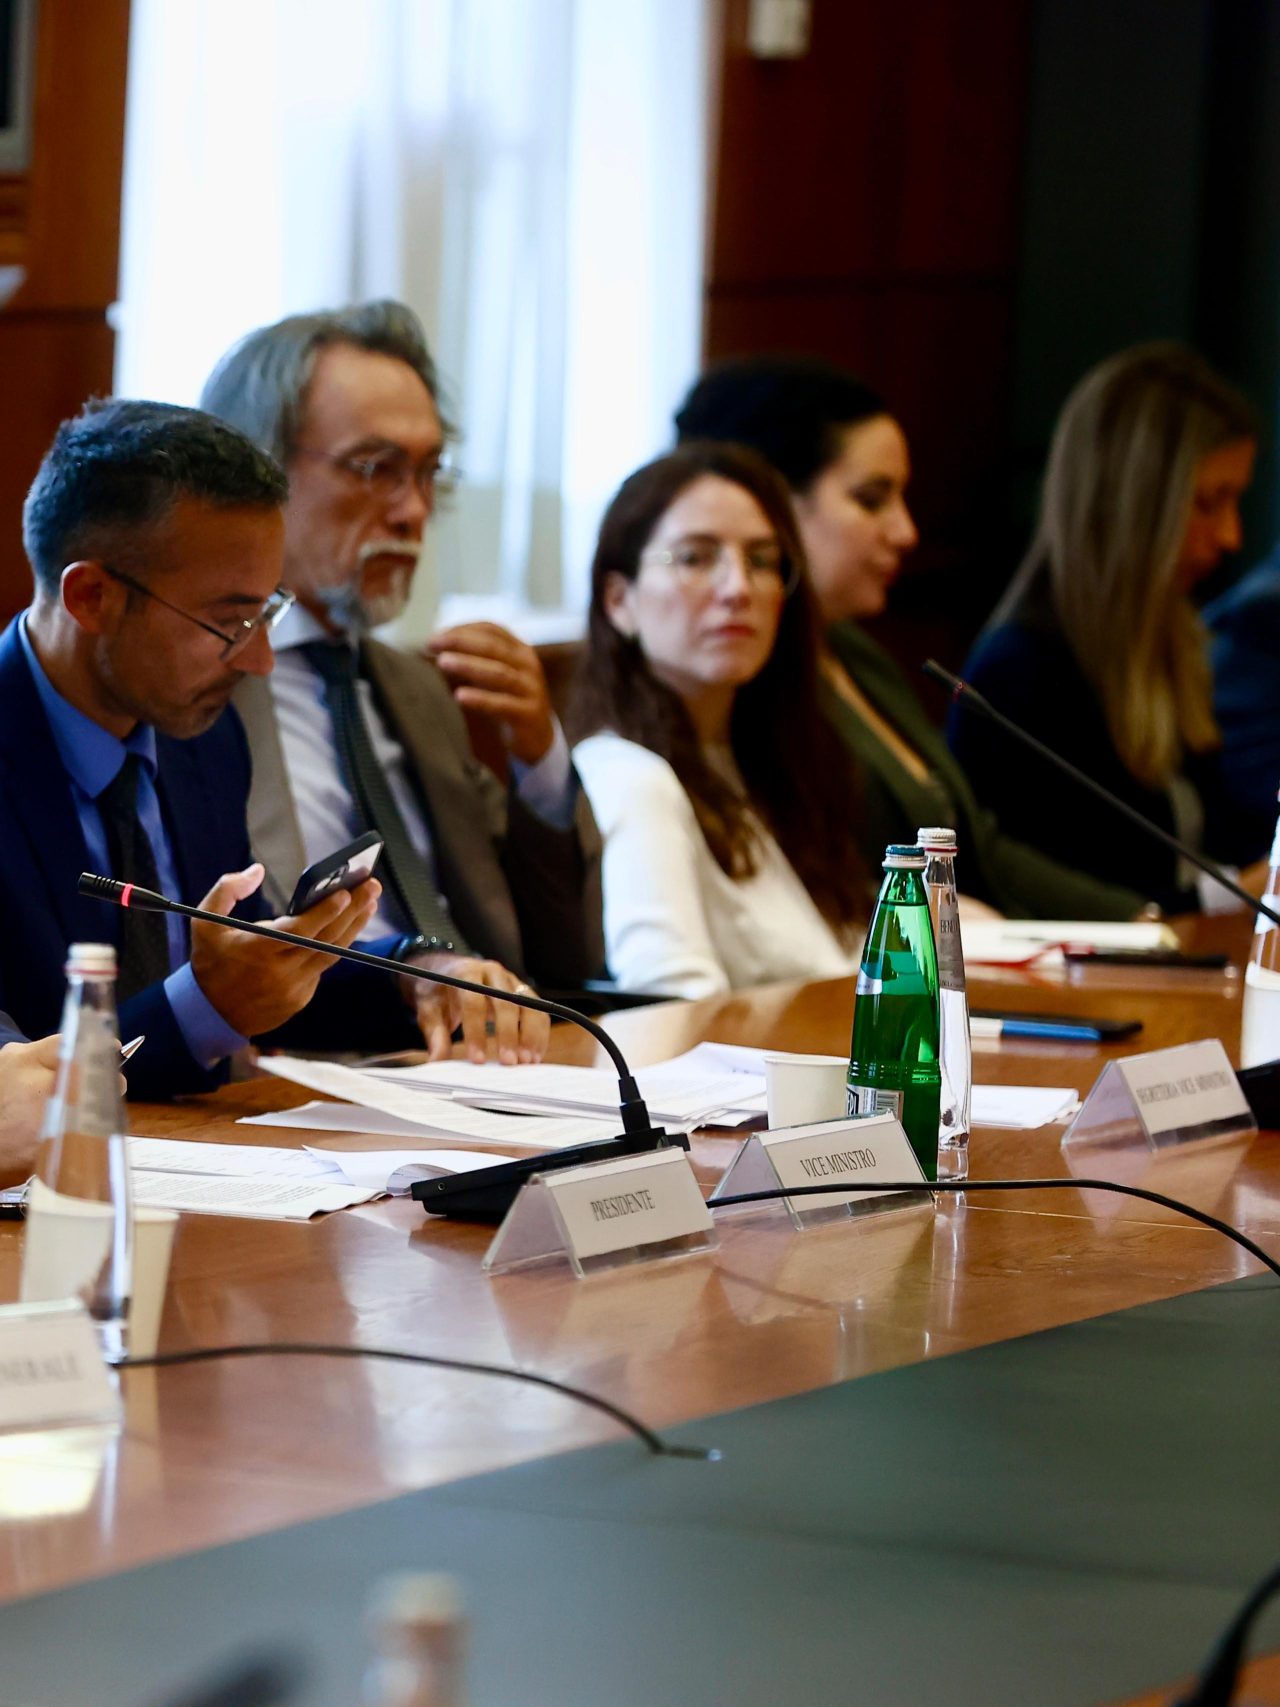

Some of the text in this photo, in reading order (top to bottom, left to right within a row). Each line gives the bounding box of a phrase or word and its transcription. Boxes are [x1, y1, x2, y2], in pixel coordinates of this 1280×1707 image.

[800, 1148, 876, 1177] VICE MINISTRO
[590, 1189, 656, 1221] PRESIDENTE
